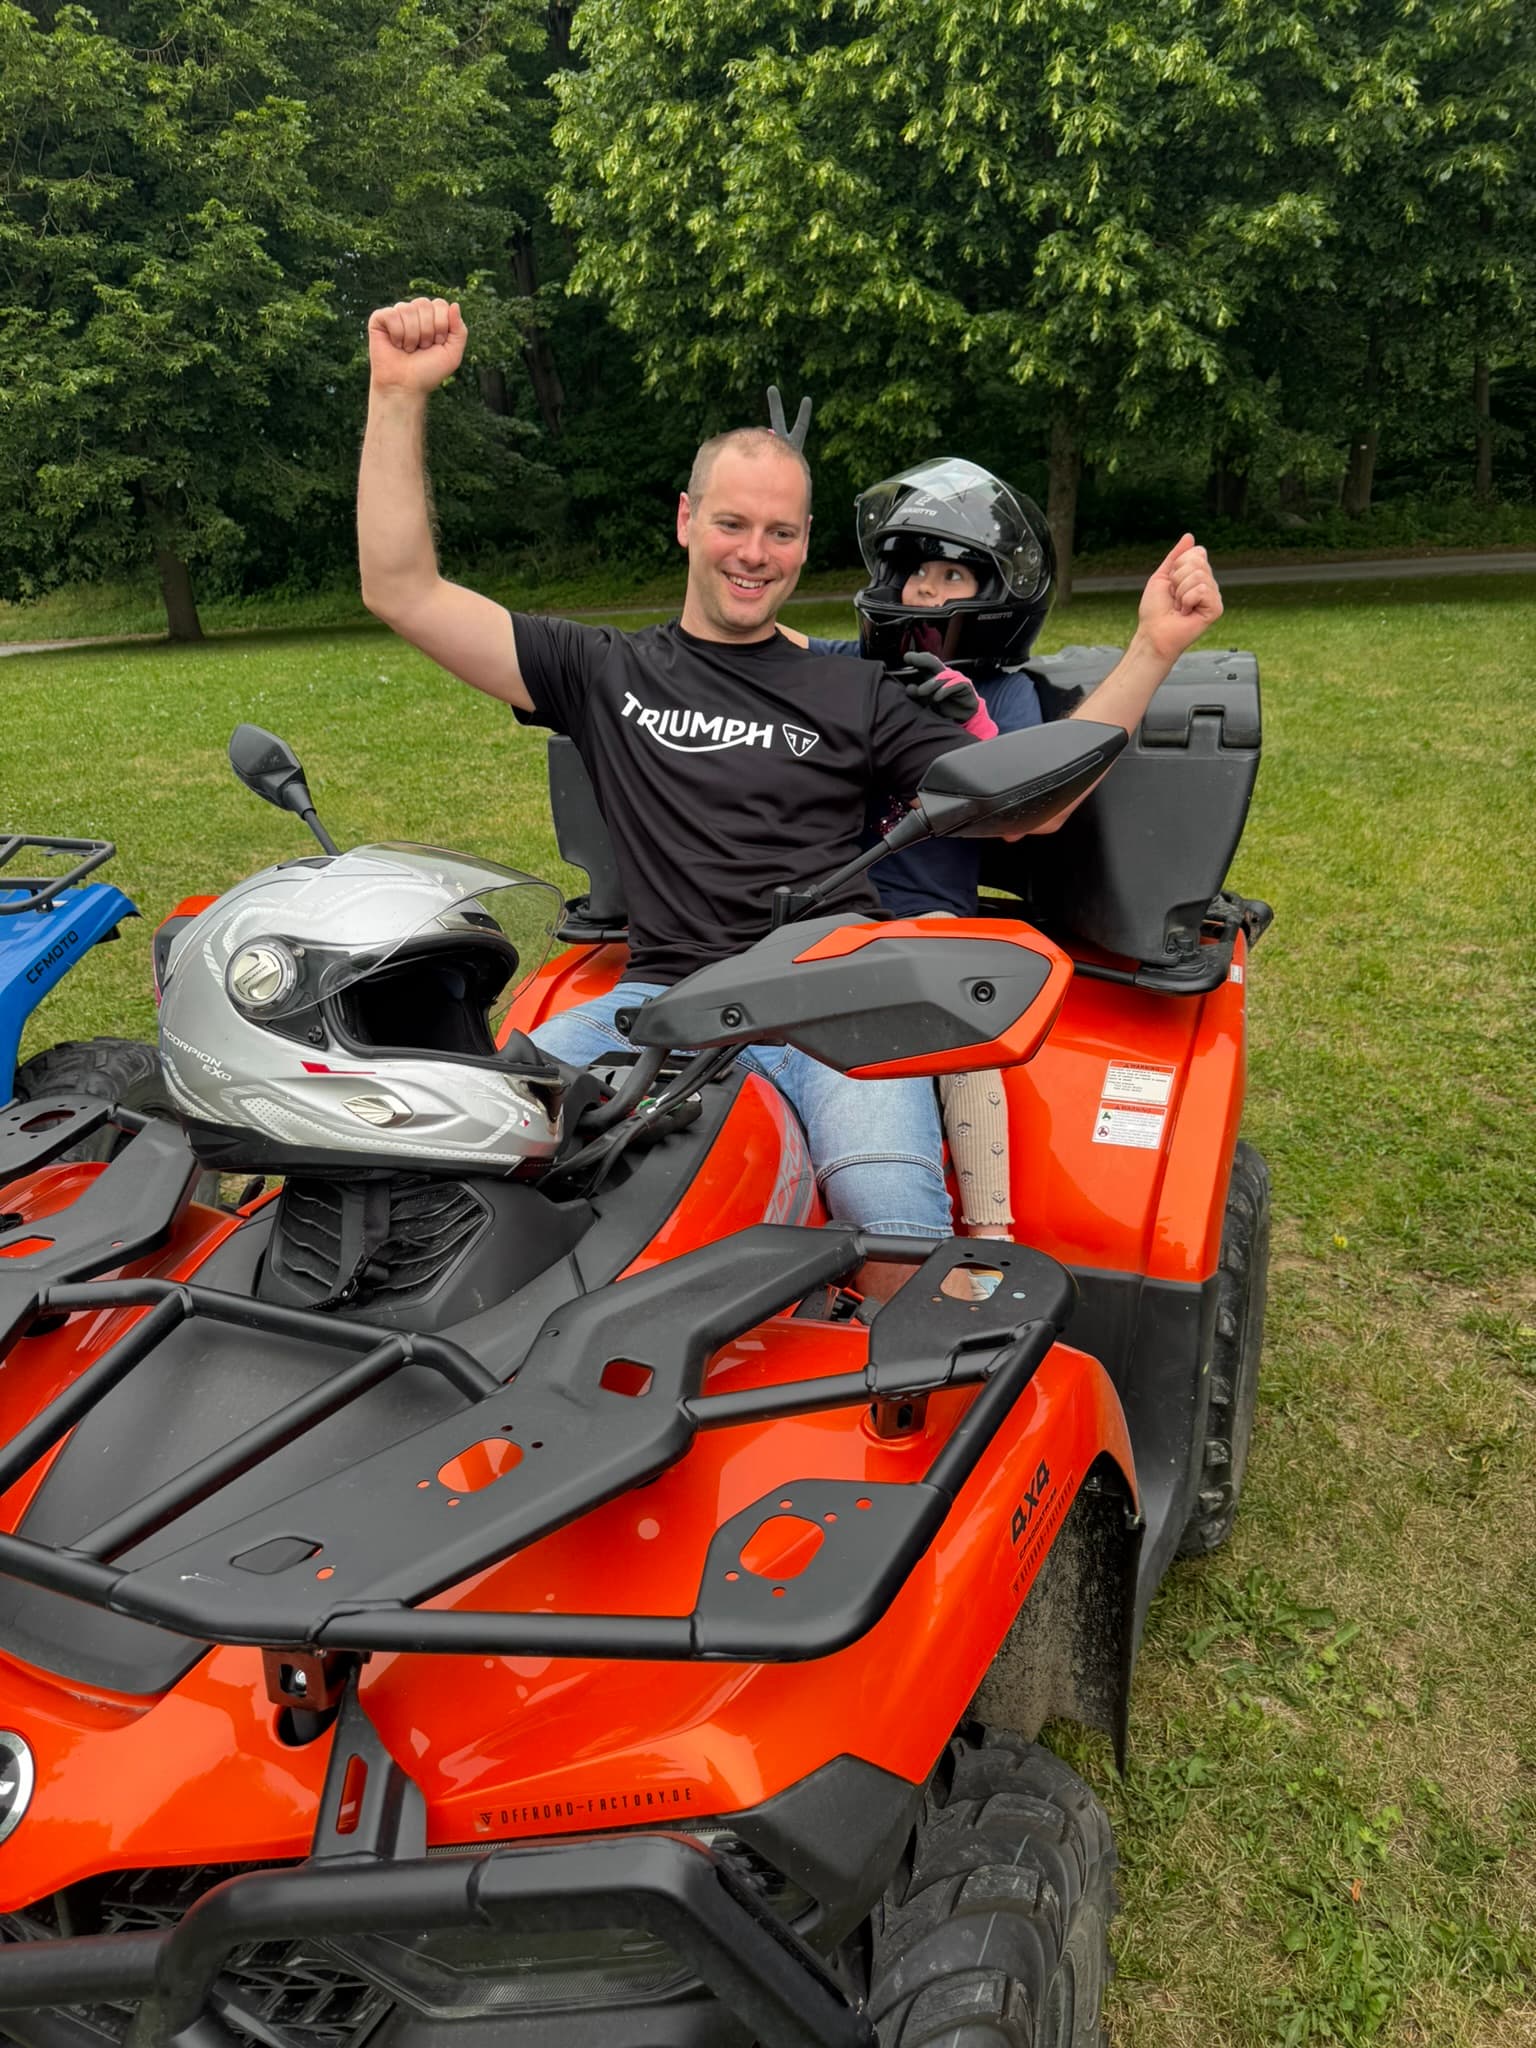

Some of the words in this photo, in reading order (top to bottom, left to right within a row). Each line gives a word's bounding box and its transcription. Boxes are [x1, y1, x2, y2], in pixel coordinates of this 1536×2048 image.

[621, 691, 774, 752] TRIUMPH
[25, 929, 79, 985] CFMOTO
[202, 1063, 232, 1081] EXO
[1011, 1458, 1050, 1545] 4X4
[500, 1787, 693, 1825] OFFROAD-FACTORY.DE
